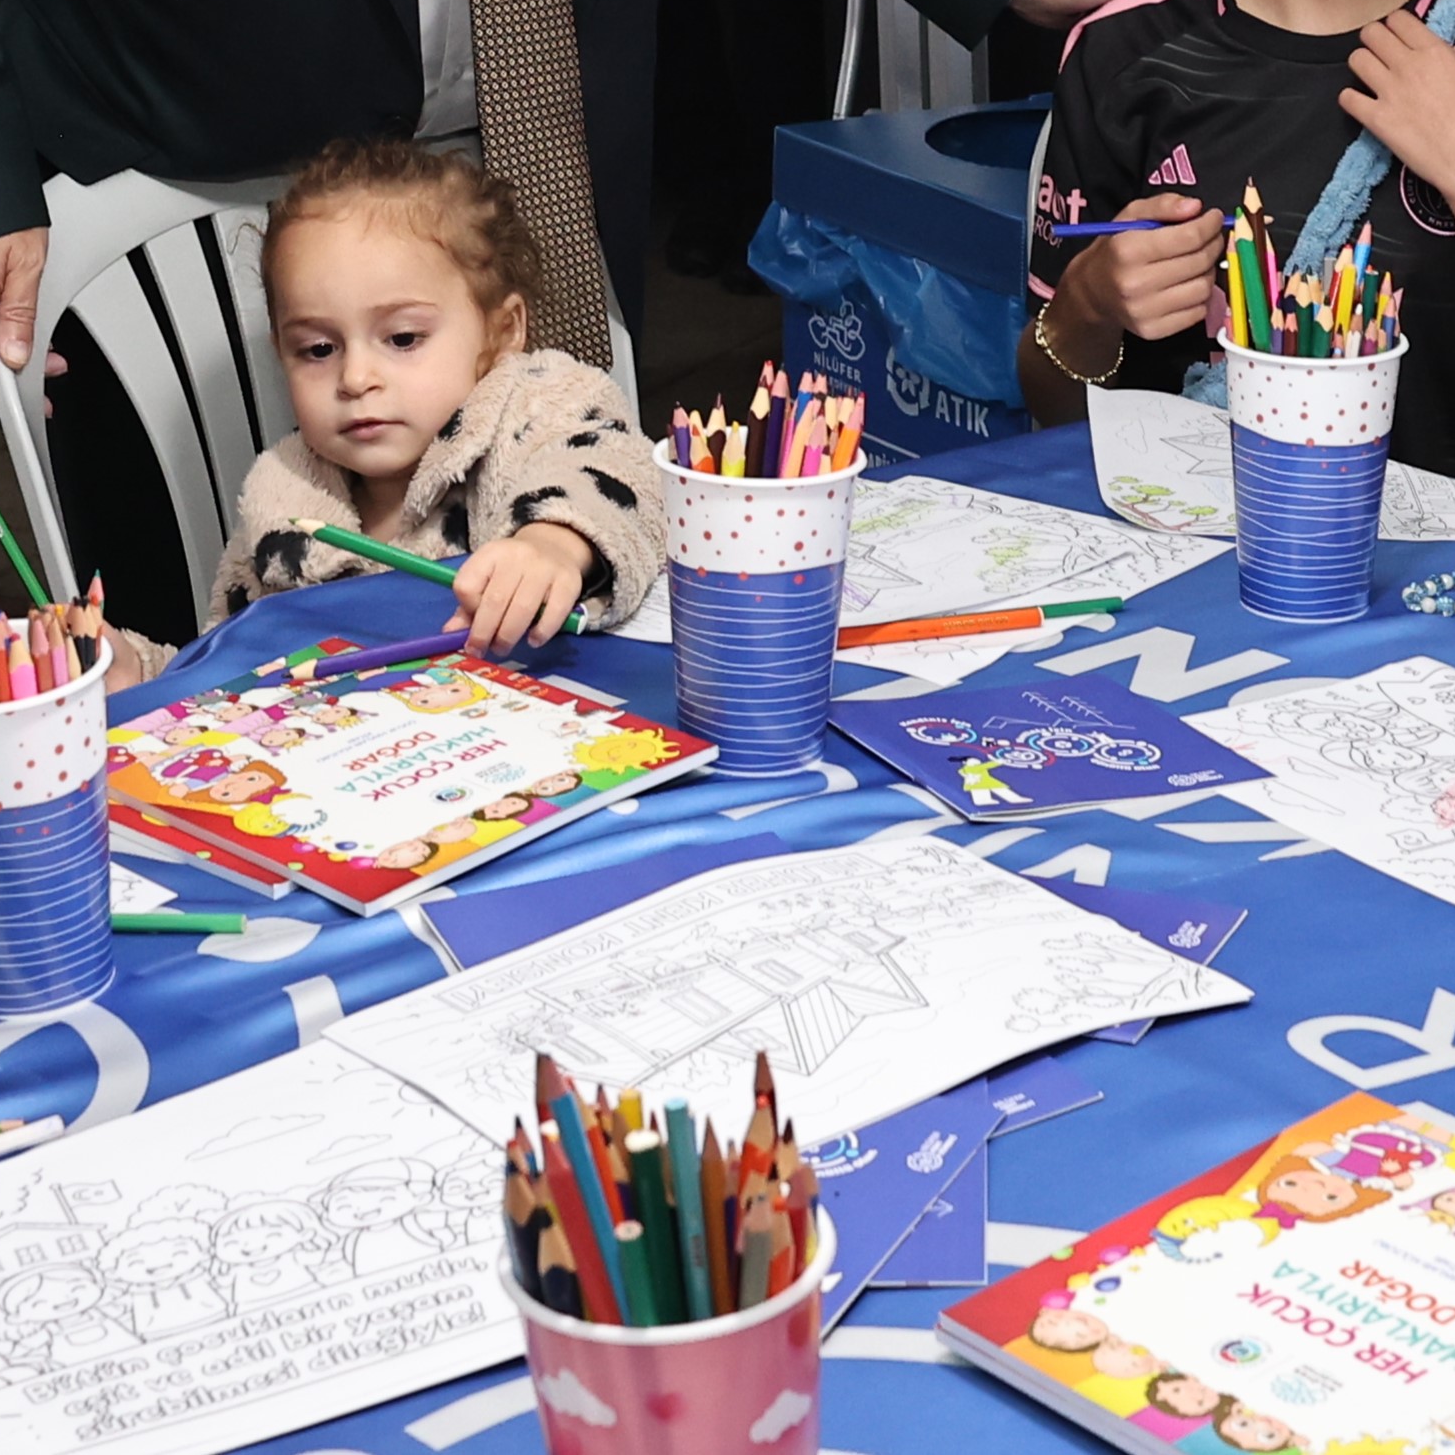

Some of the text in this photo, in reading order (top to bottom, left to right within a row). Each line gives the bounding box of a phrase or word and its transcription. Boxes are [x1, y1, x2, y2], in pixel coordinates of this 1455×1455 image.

[813, 349, 863, 384] NİLÜFER
[934, 389, 990, 439] ATIK
[334, 726, 496, 793] HAKLARIYLA
[342, 731, 436, 771] DOĞAR
[452, 739, 508, 762] HER
[361, 760, 455, 802] ÇOCUK
[1237, 1283, 1361, 1347] ÇOCUK
[147, 1370, 194, 1391] ve
[200, 1340, 275, 1377] adil
[280, 1325, 336, 1353] bir
[1354, 1343, 1427, 1384] HER
